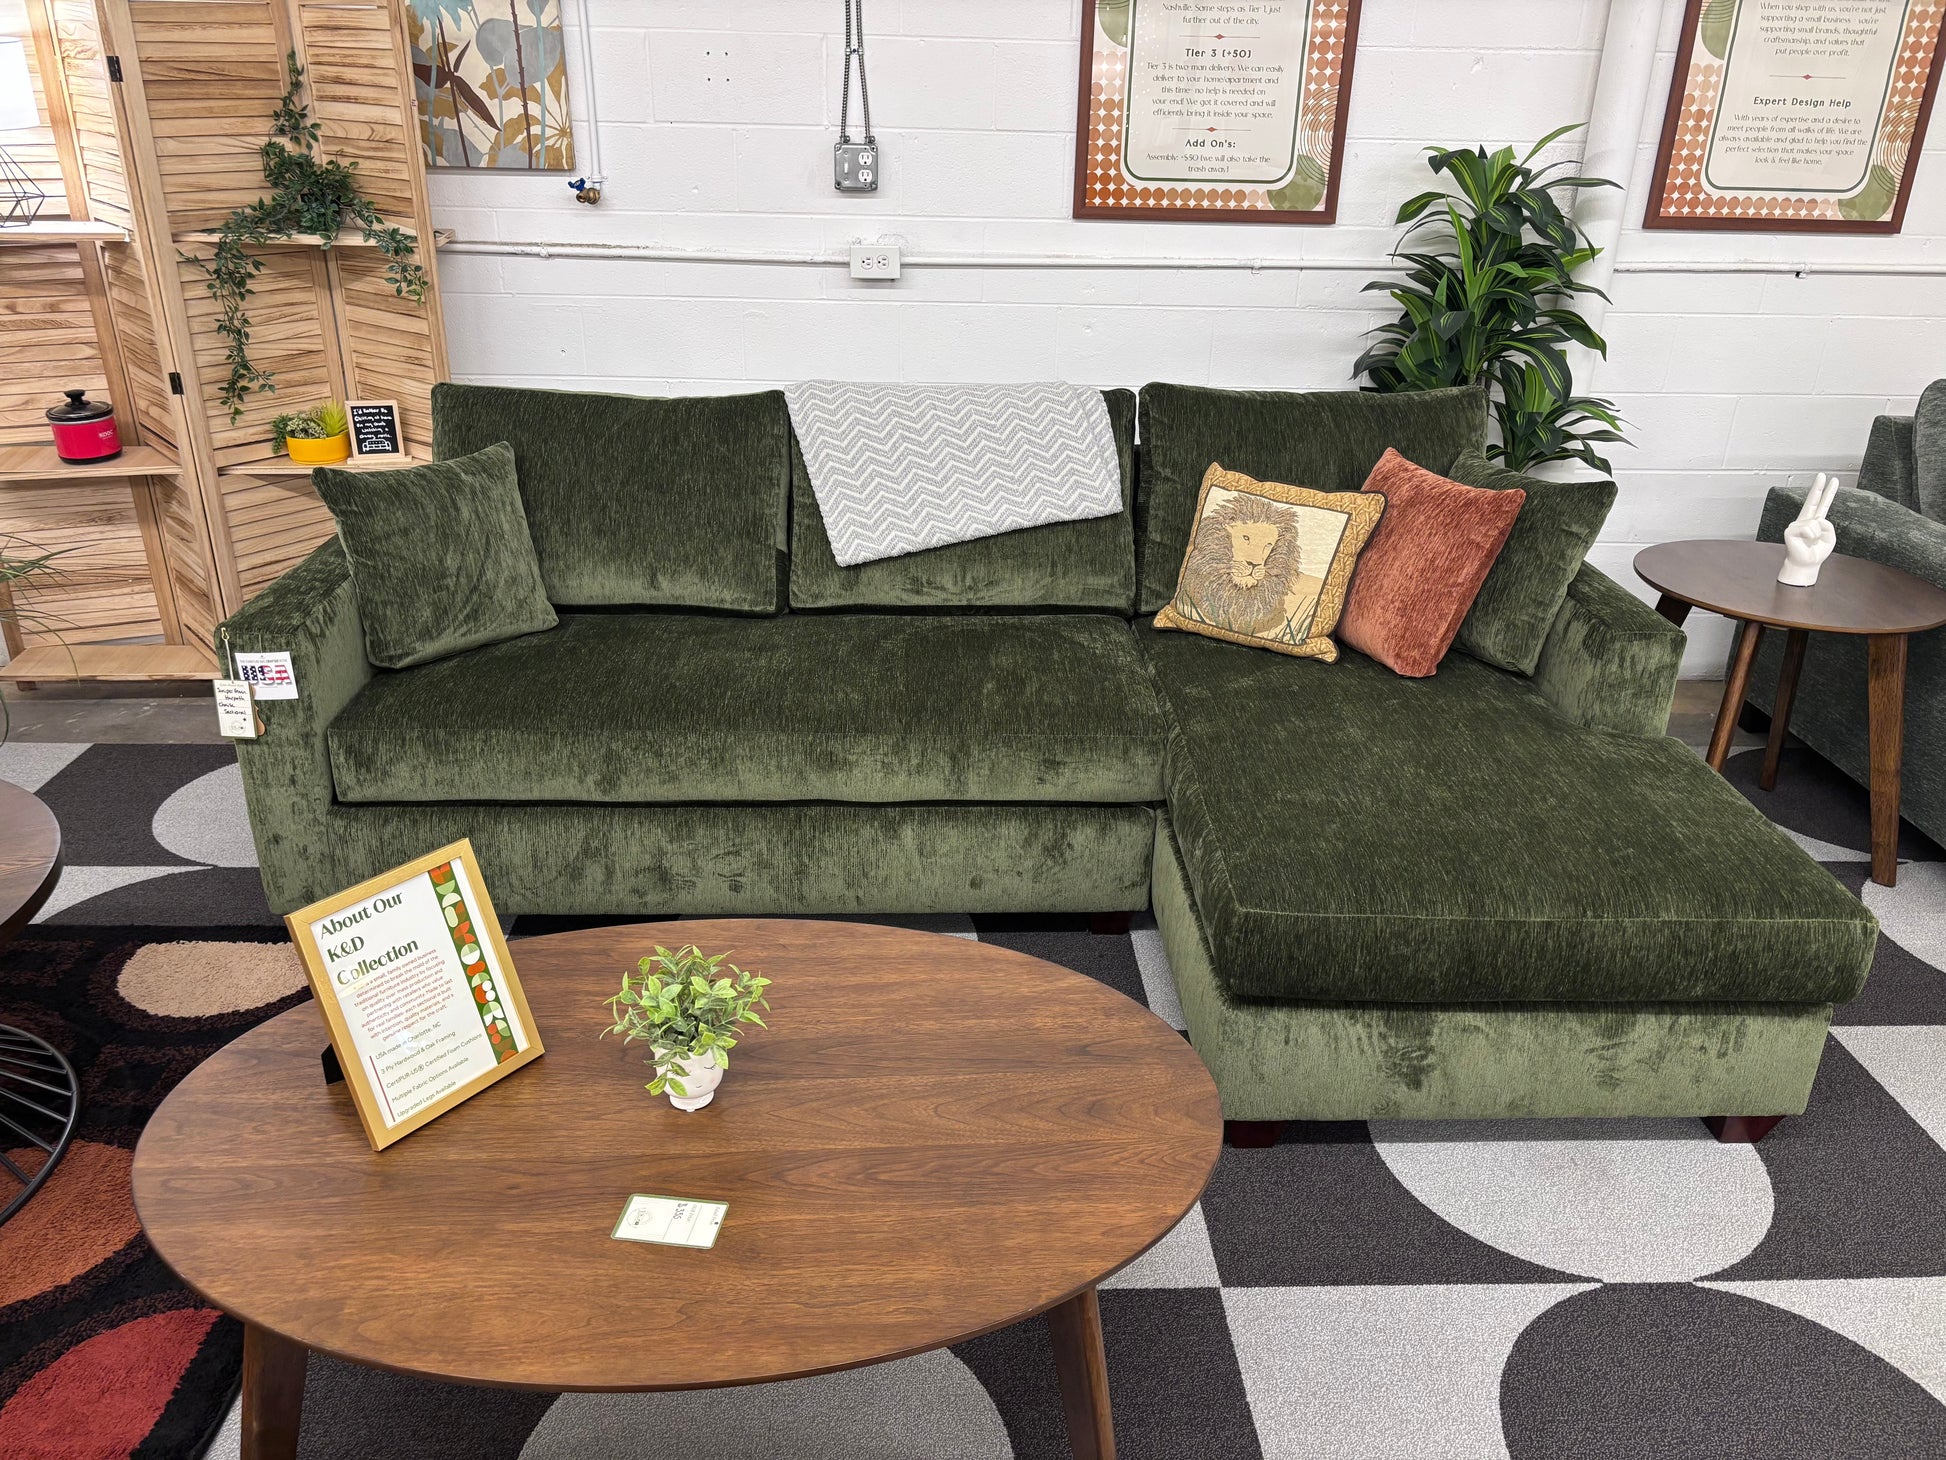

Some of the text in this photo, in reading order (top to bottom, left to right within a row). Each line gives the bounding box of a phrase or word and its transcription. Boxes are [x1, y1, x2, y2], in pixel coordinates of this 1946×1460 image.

[1162, 4, 1192, 12] Nashville.
[1194, 4, 1214, 12] Same
[1216, 5, 1234, 14] steps
[1268, 5, 1281, 14] just
[1182, 16, 1207, 24] further
[1233, 16, 1244, 24] the
[1246, 17, 1260, 26] city.
[1186, 49, 1206, 57] Tier
[1148, 62, 1158, 70] Tier
[1208, 63, 1235, 73] delivery.
[1266, 64, 1284, 74] easily
[1152, 74, 1174, 82] deliver
[1186, 76, 1200, 84] your
[1161, 85, 1255, 96] this help needed
[1152, 99, 1166, 107] your
[1200, 99, 1211, 107] got
[1220, 98, 1248, 106] covered
[1265, 99, 1276, 107] will
[1753, 96, 1852, 109] Expert Design Help
[1152, 108, 1184, 118] efficiently
[1186, 109, 1205, 119] bring
[1213, 109, 1232, 117] inside
[1251, 112, 1273, 120] space.
[1185, 139, 1236, 148] Add On's:
[241, 665, 292, 685] USA
[321, 892, 401, 938] About Our
[327, 936, 364, 962] K&D
[337, 940, 417, 984] Collection
[375, 1050, 386, 1059] USA
[387, 1043, 401, 1053] made
[407, 1027, 432, 1042] Charlotte,
[432, 1021, 441, 1029] NC
[394, 1049, 420, 1066] Hardwood
[424, 1041, 435, 1049] Oak
[435, 1031, 455, 1043] Framing
[424, 1033, 482, 1066] Certified Foam Cushions
[391, 1057, 468, 1102] Multiple Fabric Options Available
[397, 1081, 456, 1117] Upgraded Legs Available
